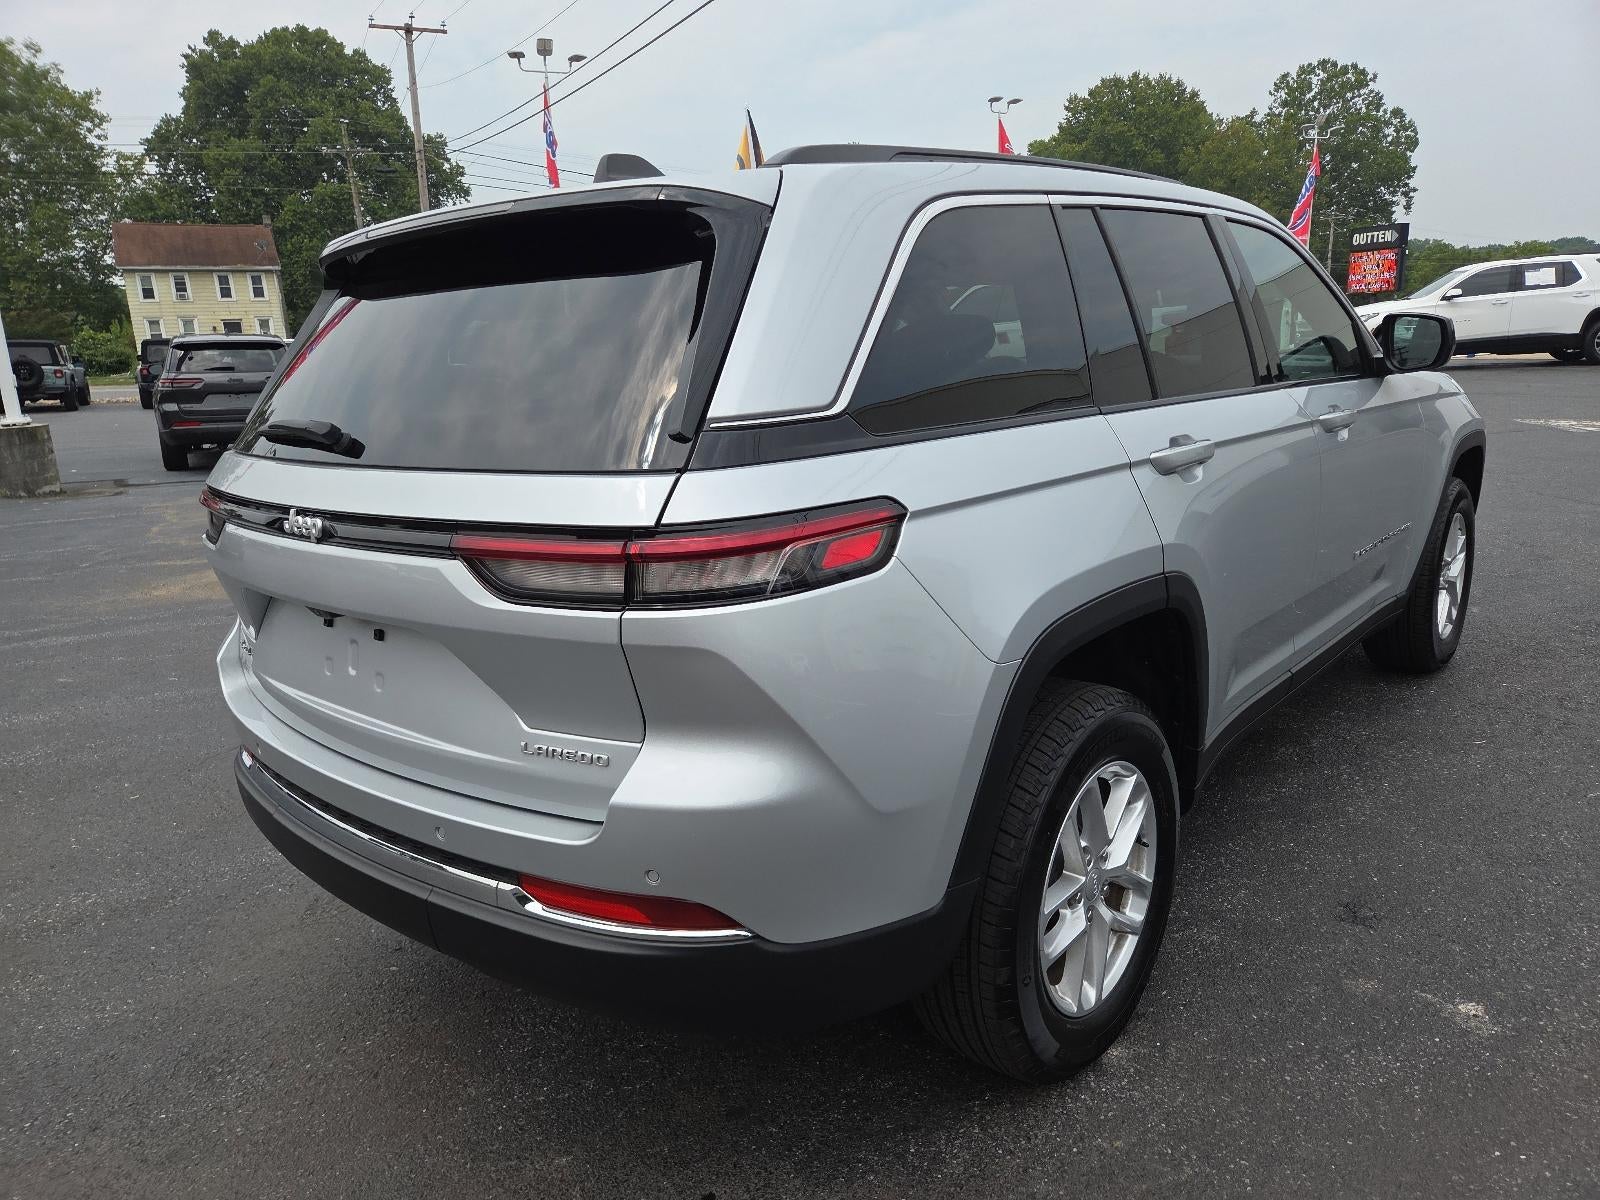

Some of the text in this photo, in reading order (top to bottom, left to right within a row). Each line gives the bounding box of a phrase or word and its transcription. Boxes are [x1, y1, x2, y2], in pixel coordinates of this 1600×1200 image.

[1352, 229, 1393, 246] OUTTEN
[283, 508, 323, 543] Jeep
[520, 741, 610, 768] LAREDO
